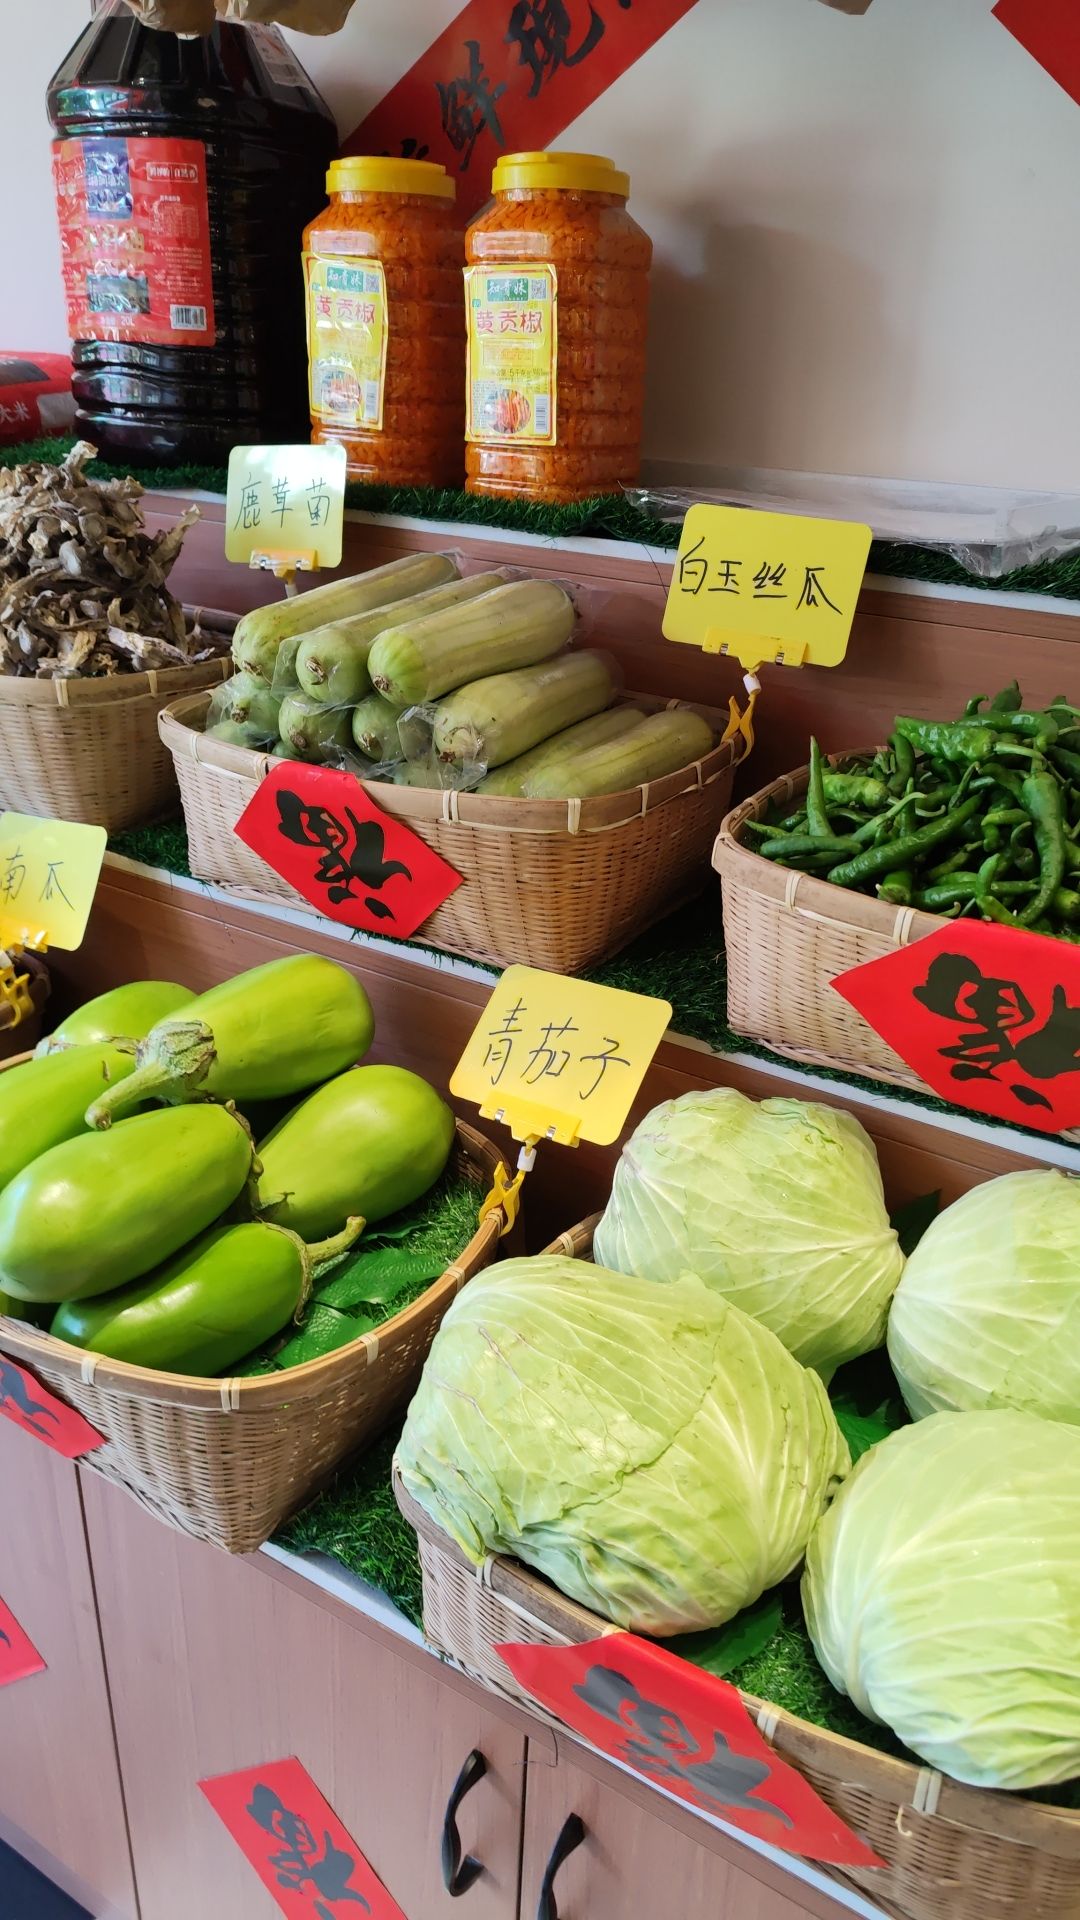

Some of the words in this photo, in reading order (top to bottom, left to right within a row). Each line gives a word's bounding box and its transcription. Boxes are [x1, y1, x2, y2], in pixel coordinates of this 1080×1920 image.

[316, 296, 377, 325] 黄贡椒
[476, 310, 543, 334] 黄贡椒
[233, 471, 331, 532] 鹿茸菌
[679, 536, 843, 616] 白玉丝瓜
[0, 845, 76, 912] 南瓜
[482, 997, 631, 1101] 青茄子
